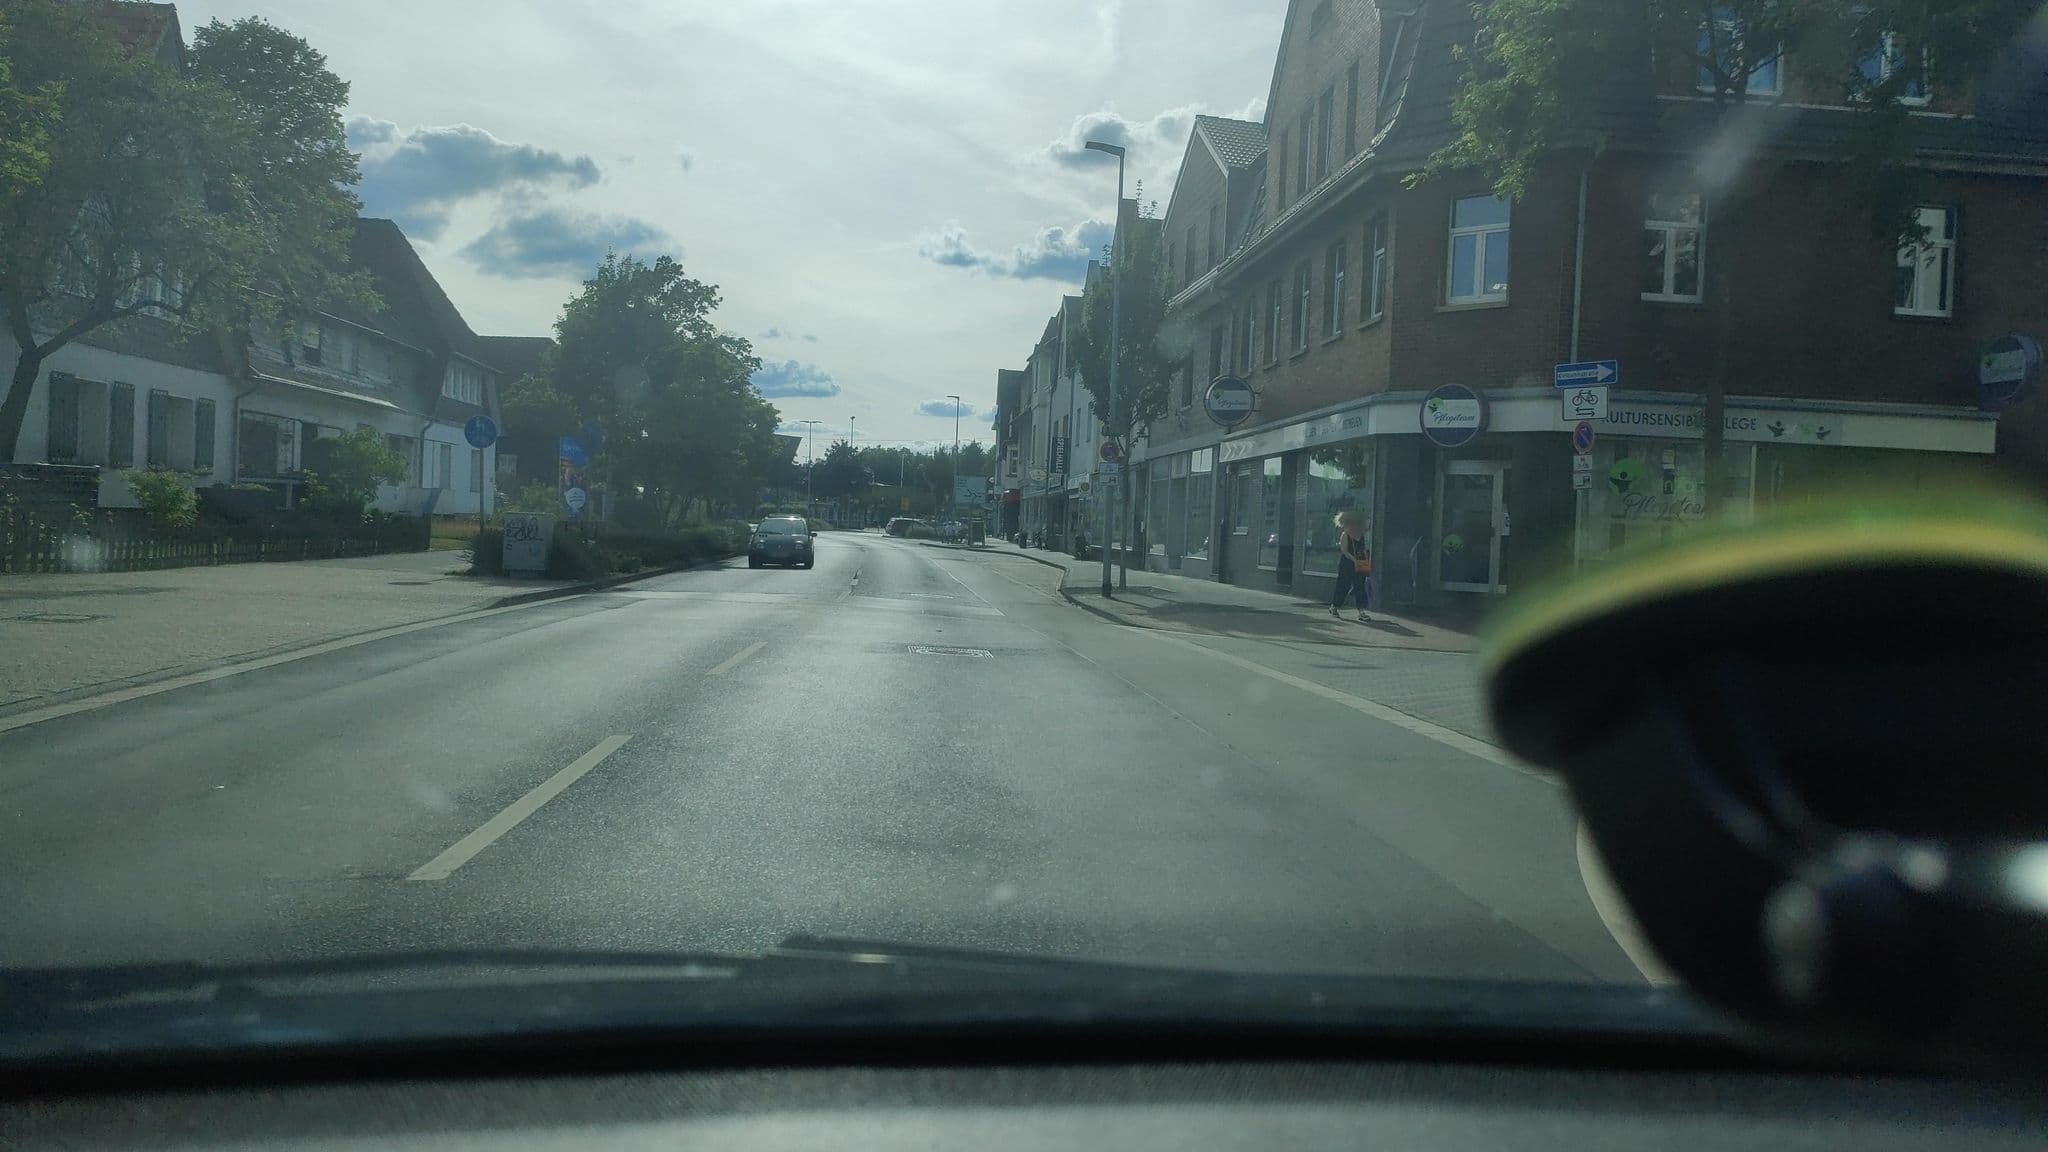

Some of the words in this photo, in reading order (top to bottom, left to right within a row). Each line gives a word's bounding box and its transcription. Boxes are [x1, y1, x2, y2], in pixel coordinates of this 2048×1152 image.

[1606, 411, 1700, 428] ULTURSENSIB
[1725, 416, 1759, 431] LEGE
[1055, 438, 1065, 474] SPIELHALLE
[1623, 493, 1706, 521] Pflegetea
